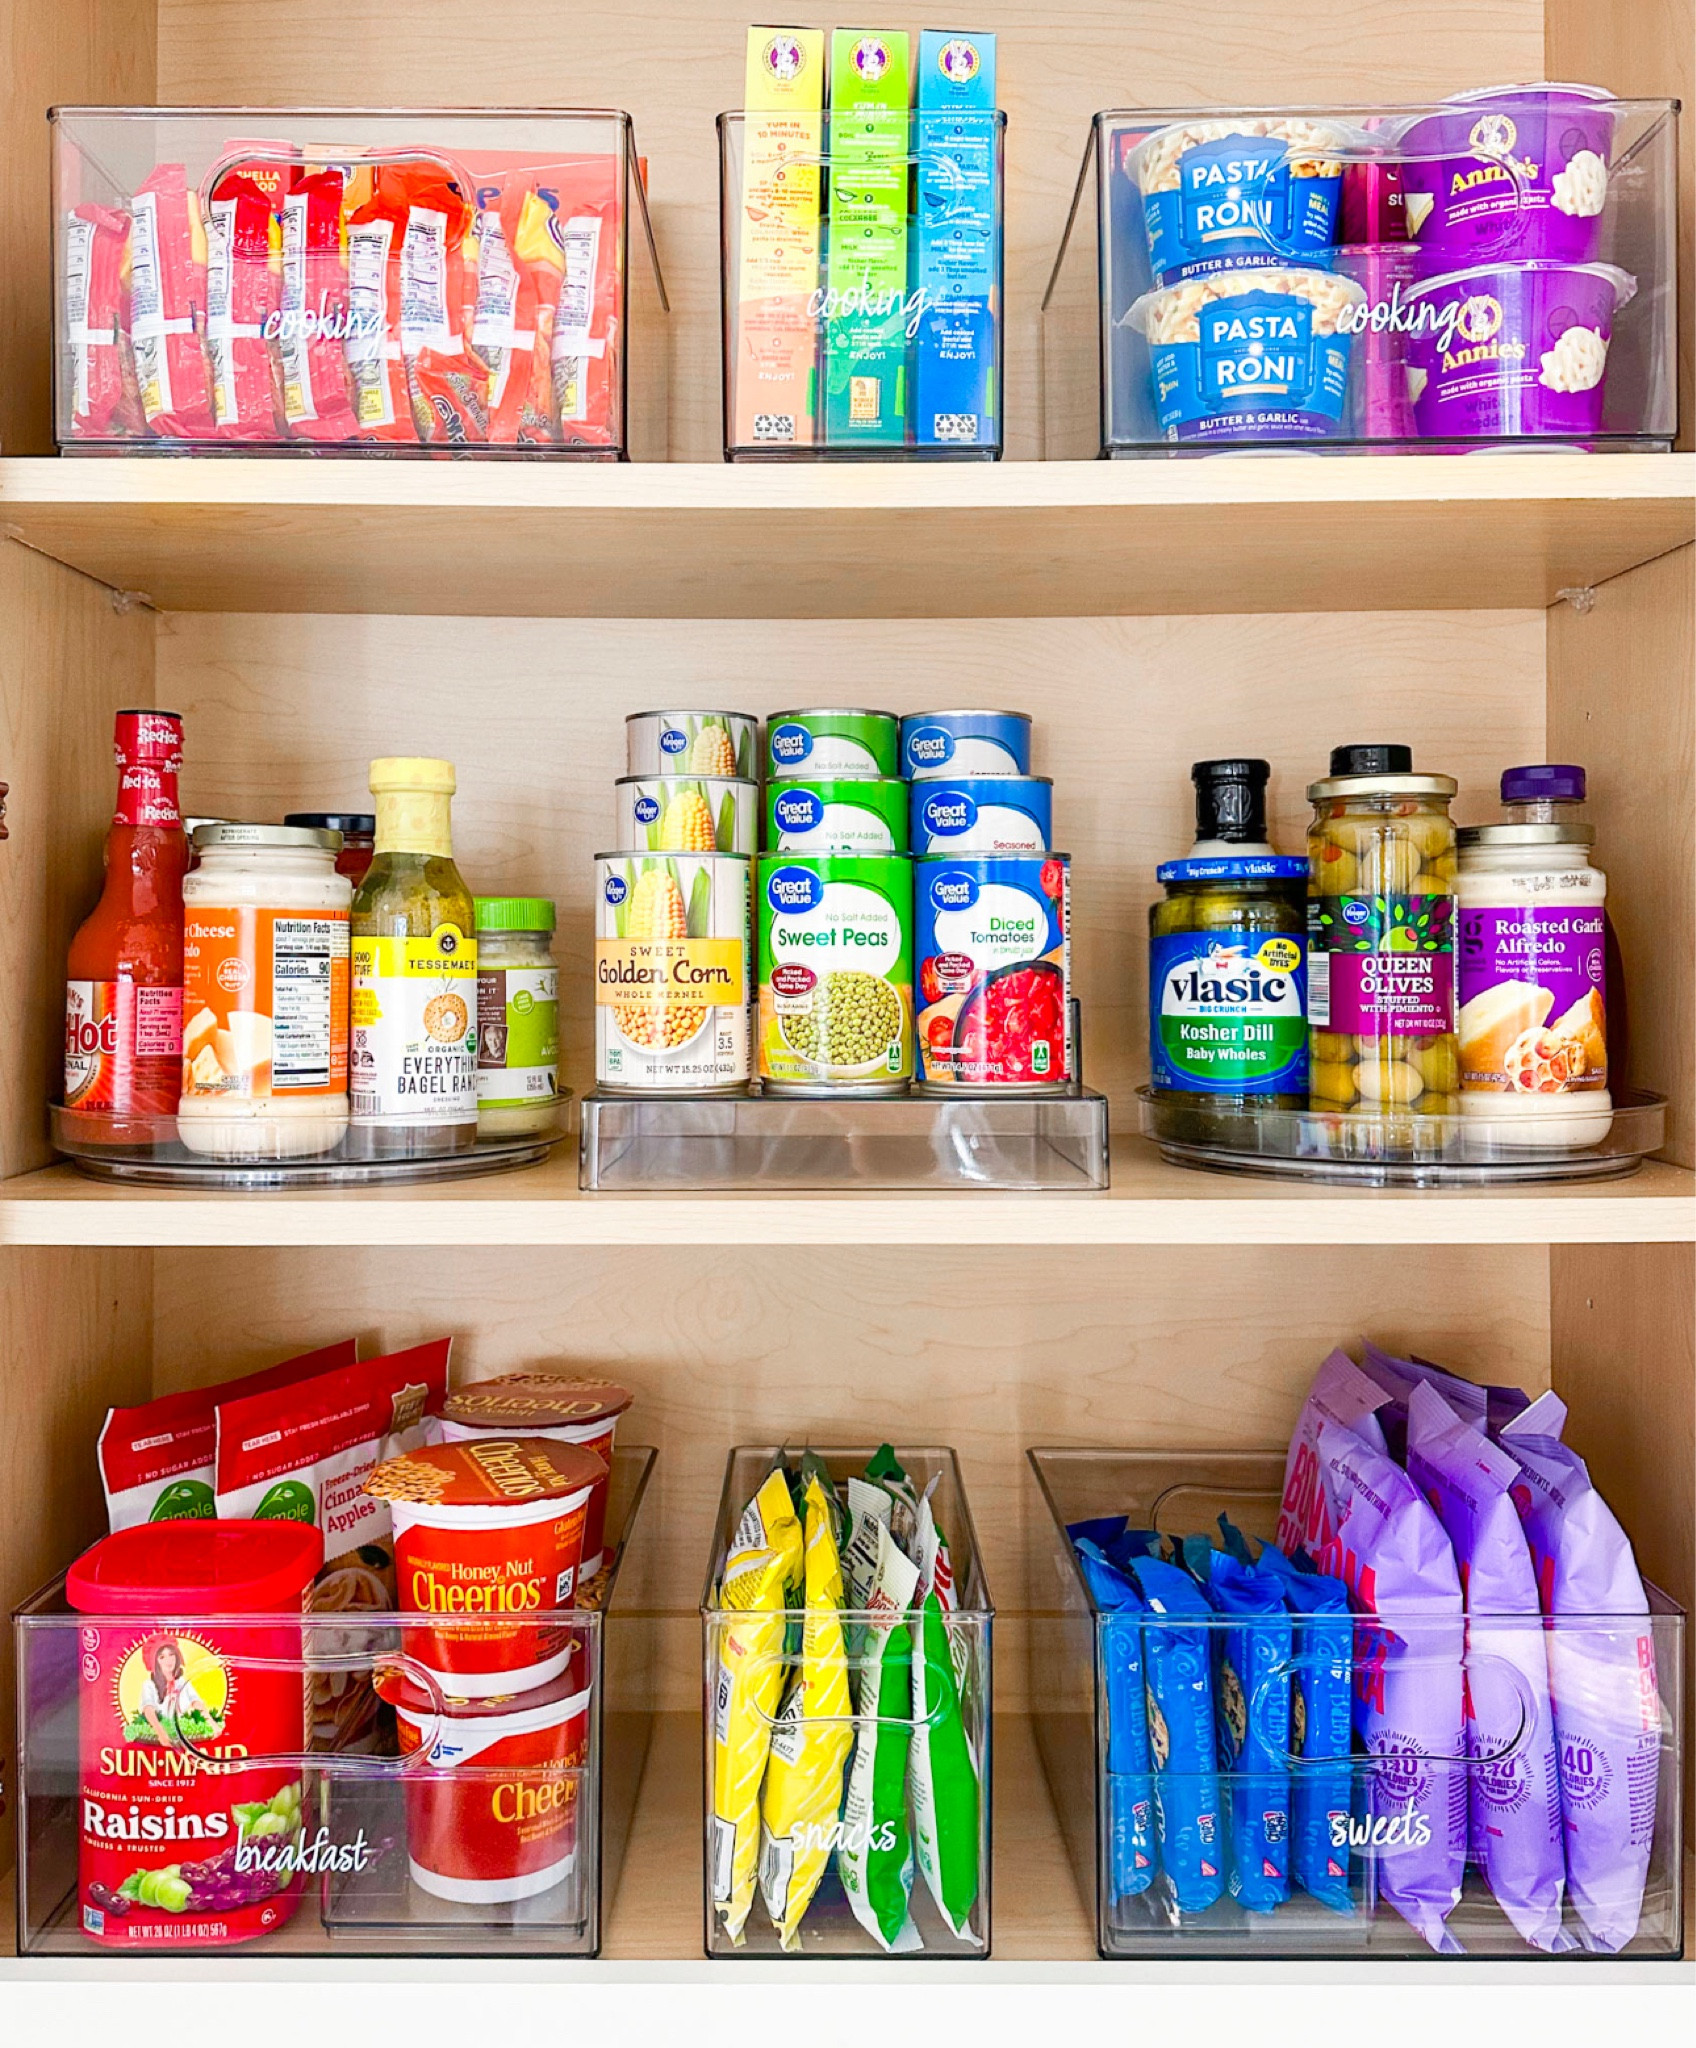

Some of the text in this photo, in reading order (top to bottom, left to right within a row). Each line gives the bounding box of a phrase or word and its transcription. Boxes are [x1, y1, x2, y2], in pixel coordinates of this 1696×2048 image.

[1192, 158, 1276, 189] PASTA
[1196, 200, 1273, 230] RONI
[1181, 256, 1277, 278] BUTTER & GARLIC
[806, 267, 932, 339] cooking
[263, 287, 391, 361] cooking
[1336, 281, 1463, 352] cooking
[1213, 316, 1298, 344] PASTA
[1441, 337, 1526, 373] Annie's
[1217, 355, 1296, 385] RONI
[1441, 385, 1460, 396] made
[1460, 381, 1478, 391] with
[1200, 413, 1298, 430] BUTTER & GARLIC
[773, 734, 804, 749] Great
[911, 735, 946, 751] Great
[779, 747, 804, 756] Value
[918, 748, 946, 759] Value
[778, 800, 812, 816] Great
[928, 802, 966, 819] Great
[785, 813, 813, 824] Value
[936, 816, 967, 828] Value
[994, 840, 1036, 850] Seasoned
[1244, 862, 1276, 874] vlasic
[772, 878, 812, 894] Great
[935, 882, 970, 896] Great
[780, 894, 812, 904] Value
[942, 894, 970, 904] Value
[860, 914, 888, 922] Added
[990, 917, 1034, 930] Diced
[1495, 918, 1569, 935] Roasted
[275, 921, 331, 934] Nutrition Facts
[778, 928, 888, 946] Sweet Peas
[970, 931, 1034, 944] Tomatoes
[630, 947, 686, 957] SWEET
[1276, 942, 1287, 950] No
[1495, 938, 1566, 954] Alfredo
[1263, 950, 1297, 960] Artificial
[275, 964, 310, 974] Calories
[598, 959, 733, 985] Golden Corn
[1361, 957, 1434, 977] QUEEN
[139, 990, 172, 998] Nutrition
[615, 990, 704, 998] WHOLE KERNEL
[1170, 970, 1287, 1003] vlasic
[1360, 977, 1434, 994] OLIVES
[1360, 1004, 1434, 1012] WITH PIMIENTO
[1377, 996, 1421, 1004] STUFFED
[1180, 1023, 1274, 1041] Kosher Dill
[718, 1037, 733, 1050] 3.5
[1186, 1048, 1266, 1062] Baby Wholes
[65, 1061, 88, 1070] NAL
[404, 1056, 476, 1074] EVERYTHIN
[398, 1076, 446, 1094] BAGEL
[144, 1461, 189, 1480] NO SUGAR
[252, 1472, 265, 1480] NO
[266, 1462, 294, 1476] SUGAR
[326, 1458, 376, 1490] Freeze-Dried
[468, 1441, 545, 1497] Cheerios
[325, 1482, 364, 1510] Cinna
[327, 1500, 376, 1534] Apples
[451, 1562, 500, 1584] Honey
[506, 1558, 534, 1577] Nut
[412, 1570, 542, 1614] Cheerios
[1564, 1746, 1593, 1776] 40
[83, 1786, 184, 1803] CALIFORNIA SUN-DRIED
[83, 1800, 229, 1840] Raisins
[790, 1801, 896, 1852] snacks
[1331, 1797, 1432, 1848] sweets
[126, 1844, 166, 1853] TRUSTED
[234, 1823, 368, 1874] breakfast
[128, 1926, 141, 1938] NET
[142, 1926, 154, 1938] WT
[163, 1926, 174, 1938] OZ
